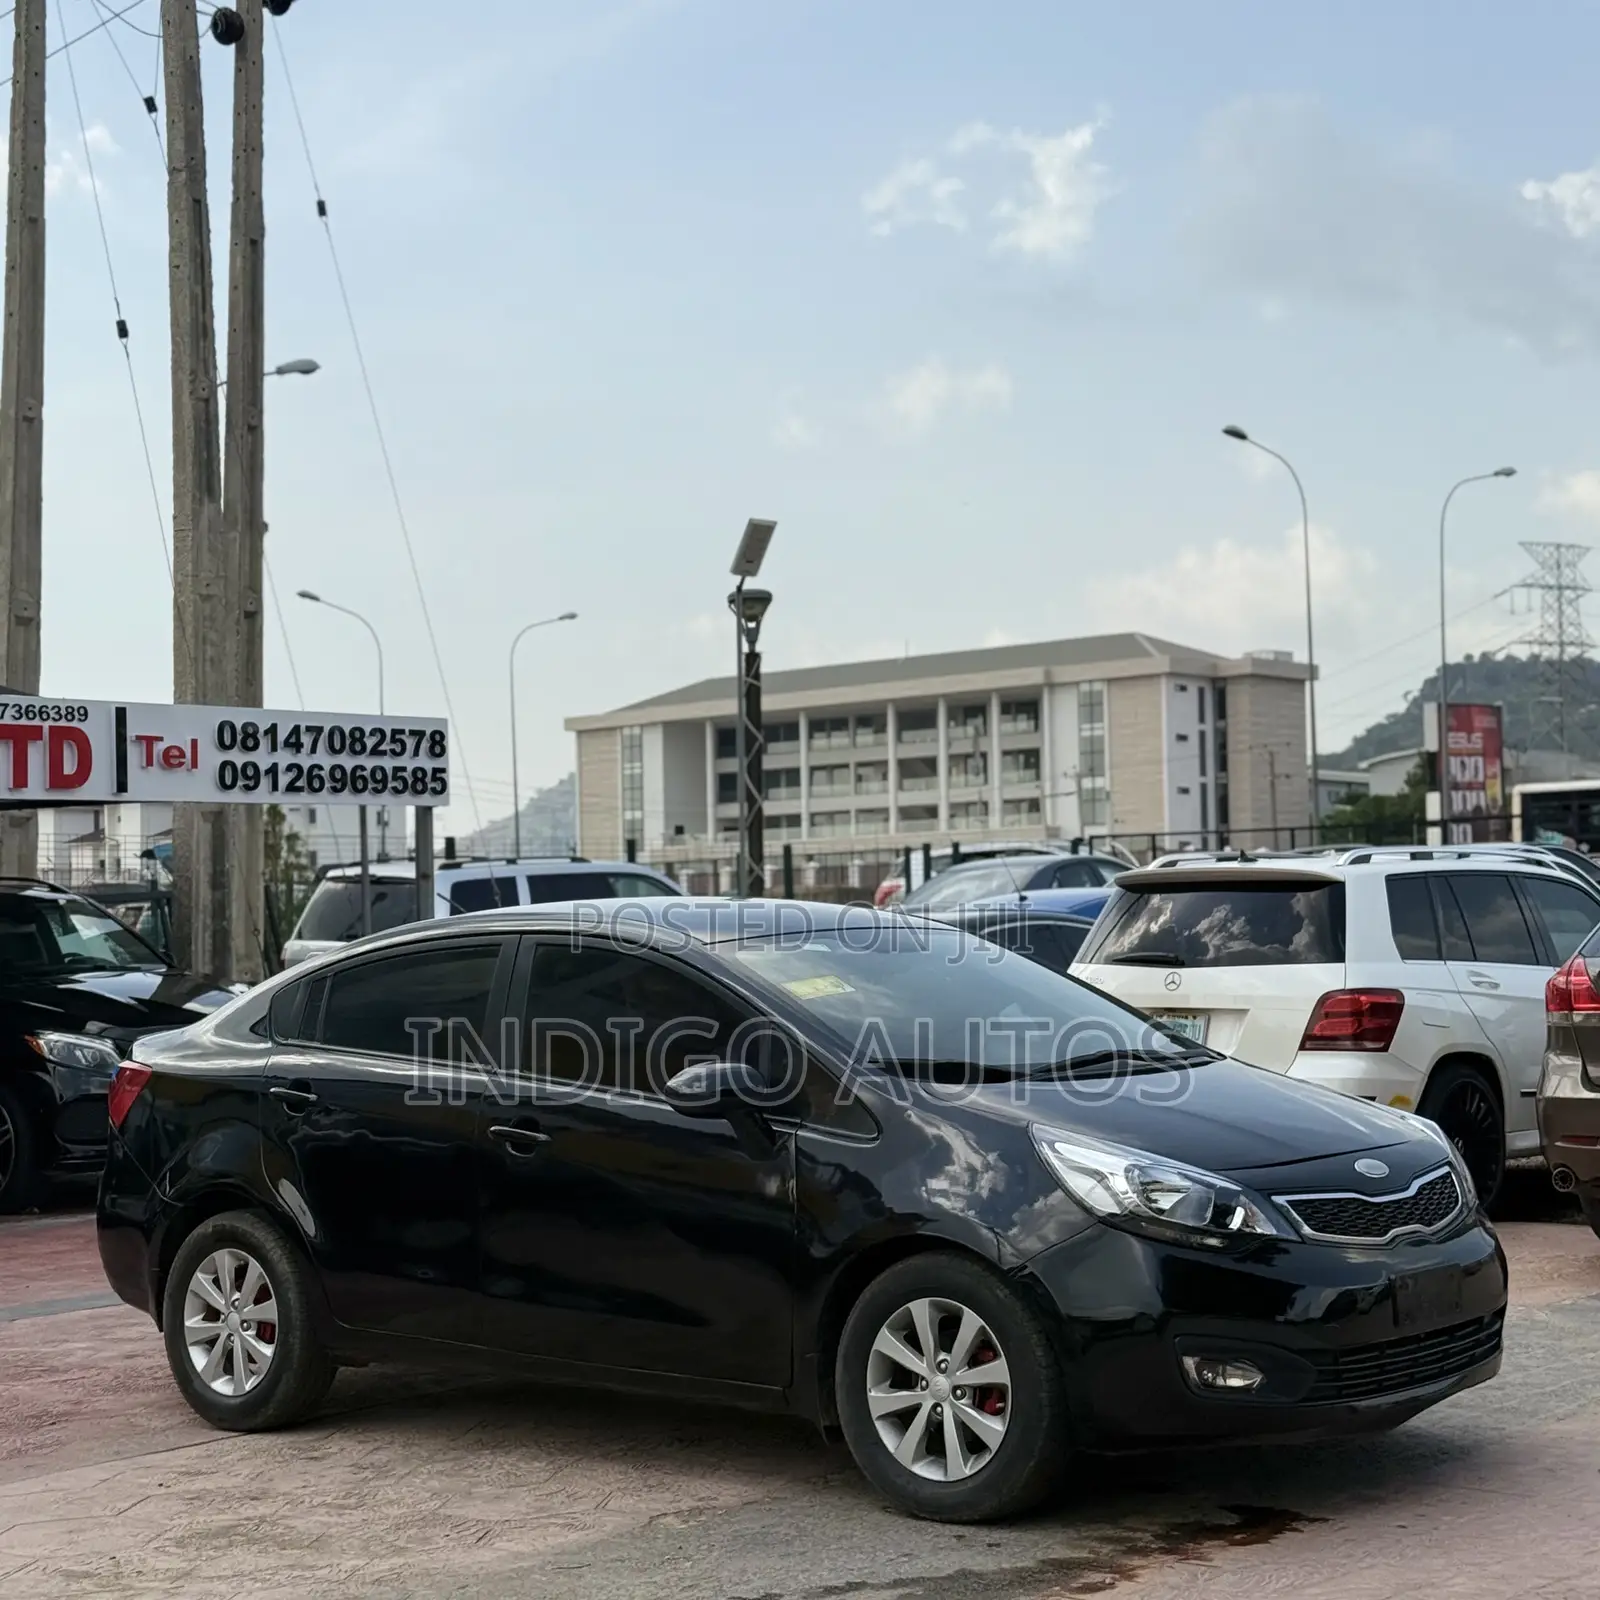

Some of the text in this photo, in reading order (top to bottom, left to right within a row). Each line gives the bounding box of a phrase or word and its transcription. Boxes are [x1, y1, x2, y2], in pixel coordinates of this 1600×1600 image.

[0, 704, 89, 722] 7366389
[132, 736, 199, 771] Tel
[216, 719, 446, 757] 08147082578
[0, 724, 93, 790] TD
[218, 760, 447, 796] 09126969585
